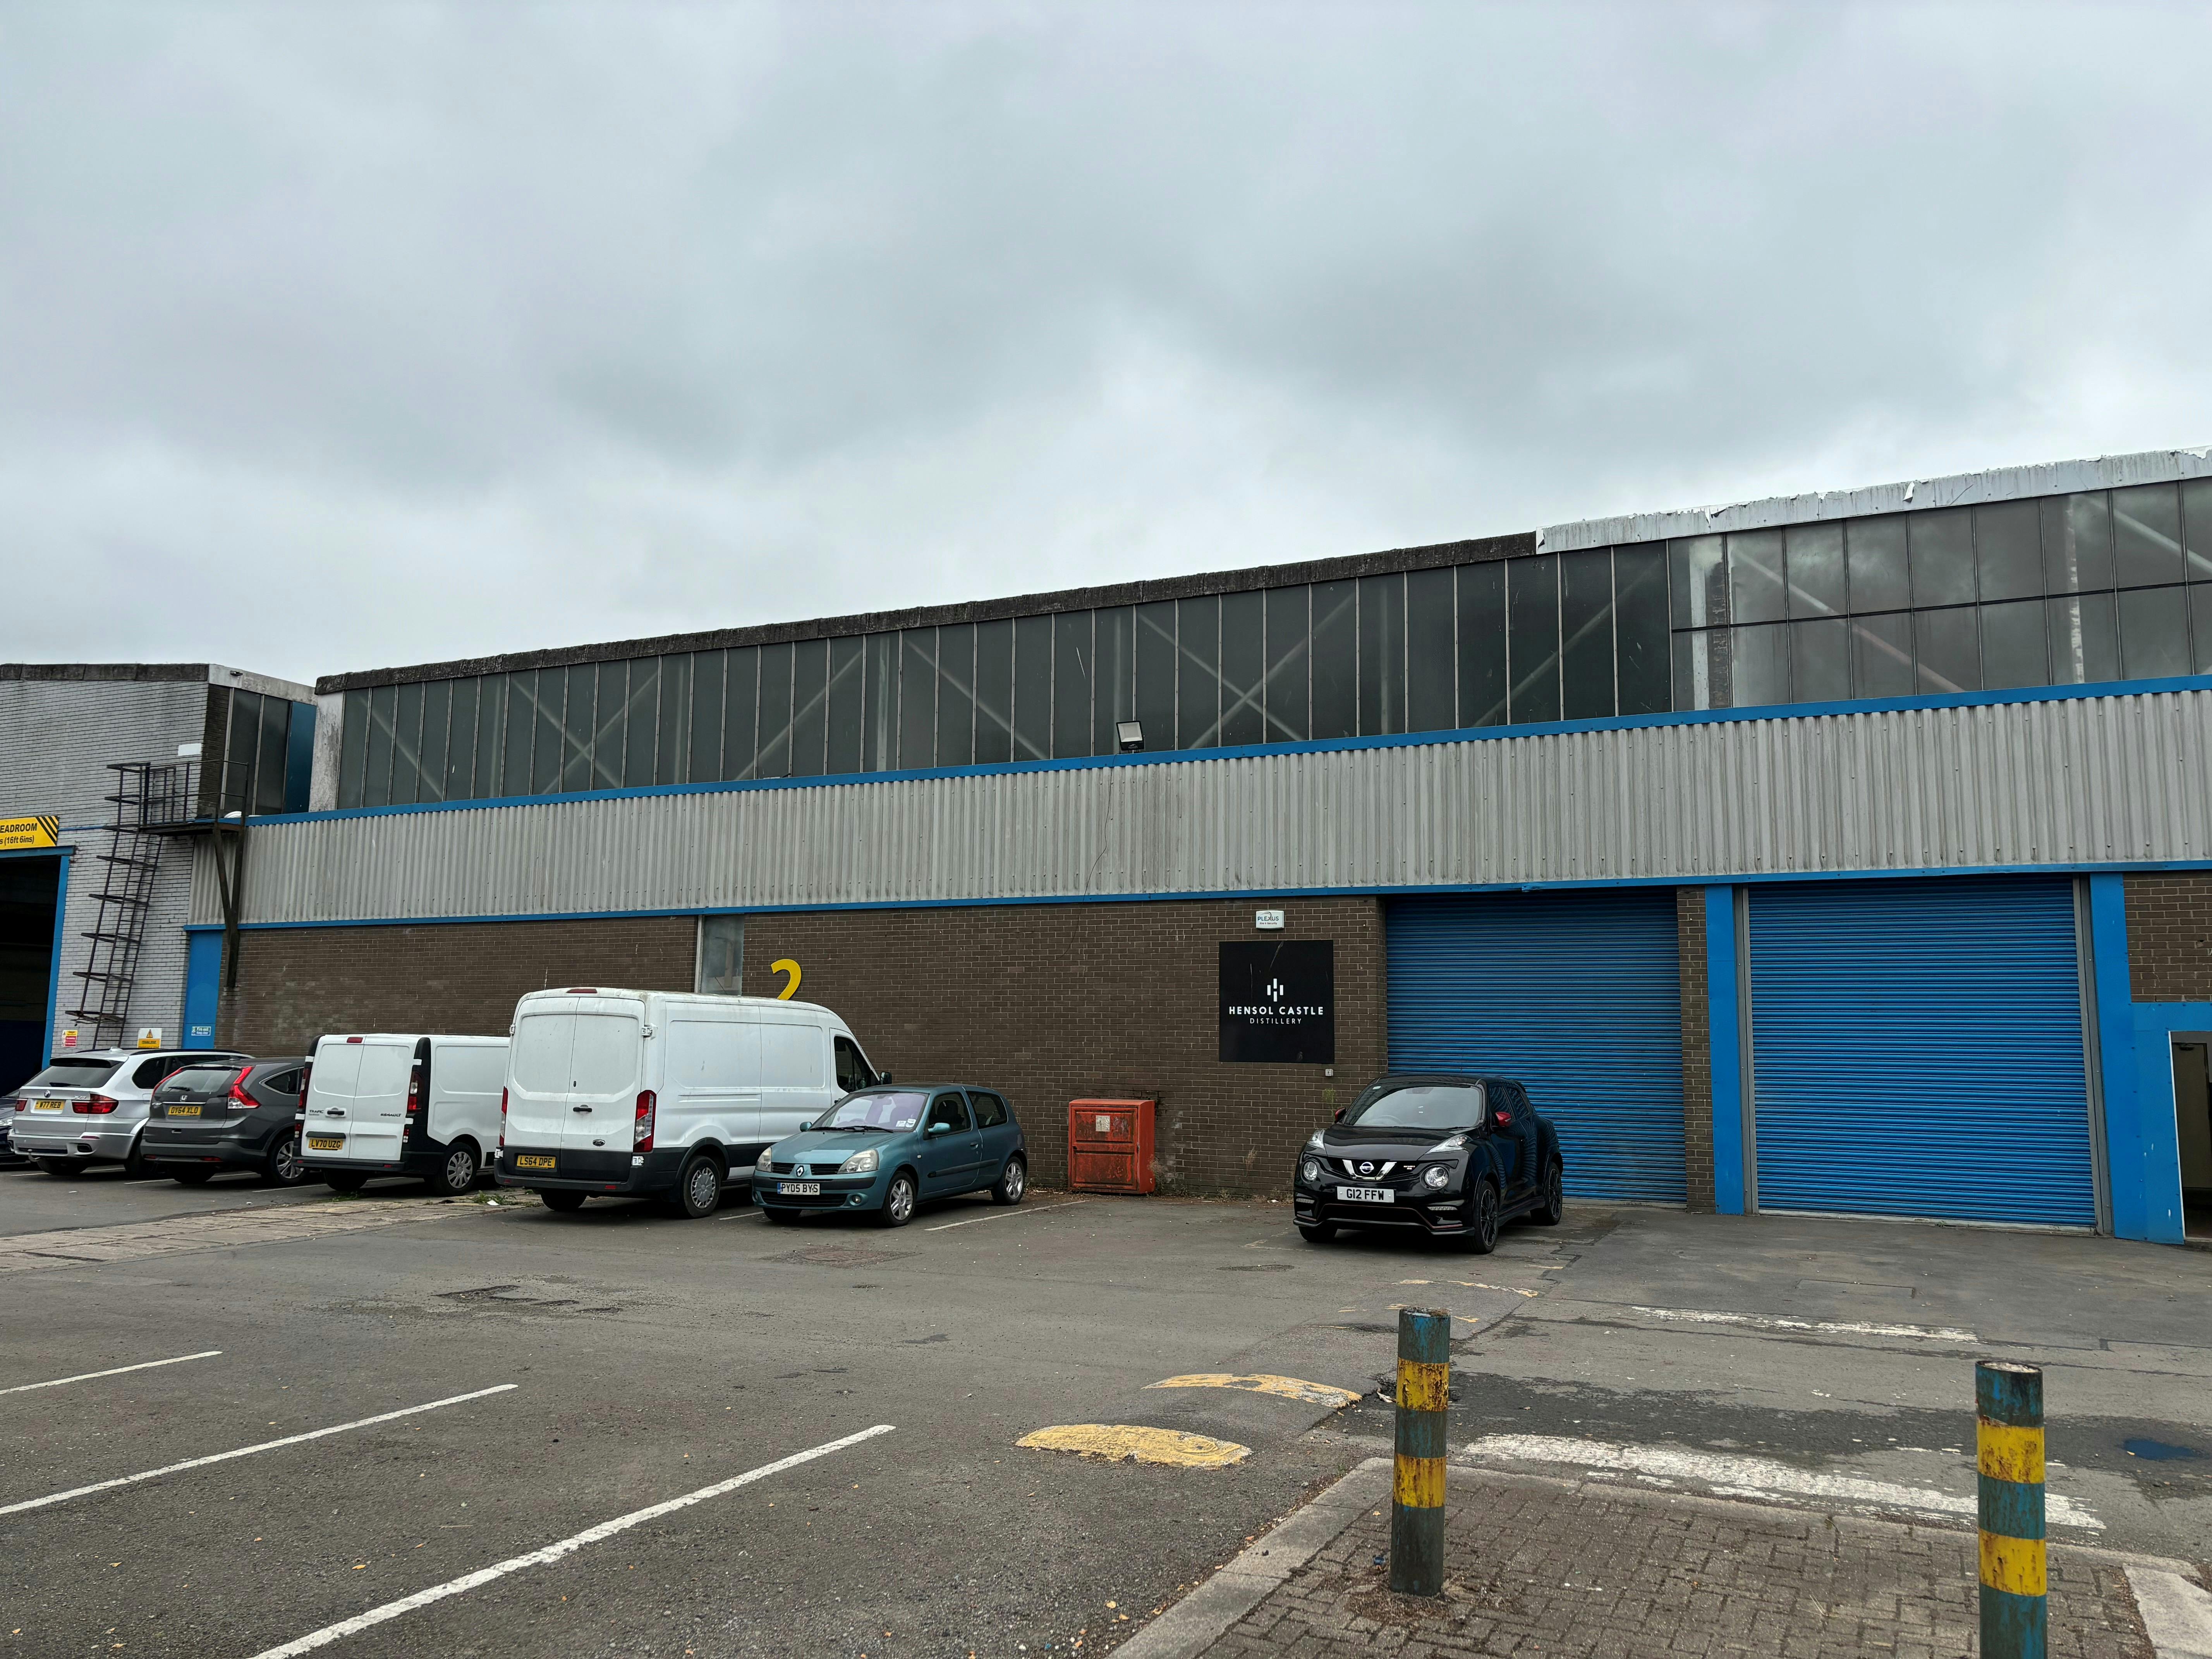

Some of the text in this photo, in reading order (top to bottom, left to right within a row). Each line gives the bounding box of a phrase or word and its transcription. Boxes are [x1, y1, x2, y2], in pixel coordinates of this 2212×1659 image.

[4, 836, 19, 846] (16ft
[20, 835, 34, 844] 6ins)
[771, 959, 801, 1001] 2
[1229, 1006, 1323, 1015] HENSOL CASTLE
[311, 1139, 341, 1148] LV70 UZG
[520, 1157, 553, 1166] LS64 DPE
[781, 1184, 818, 1193] PY05 BYS
[1346, 1189, 1384, 1200] G12 FFW
